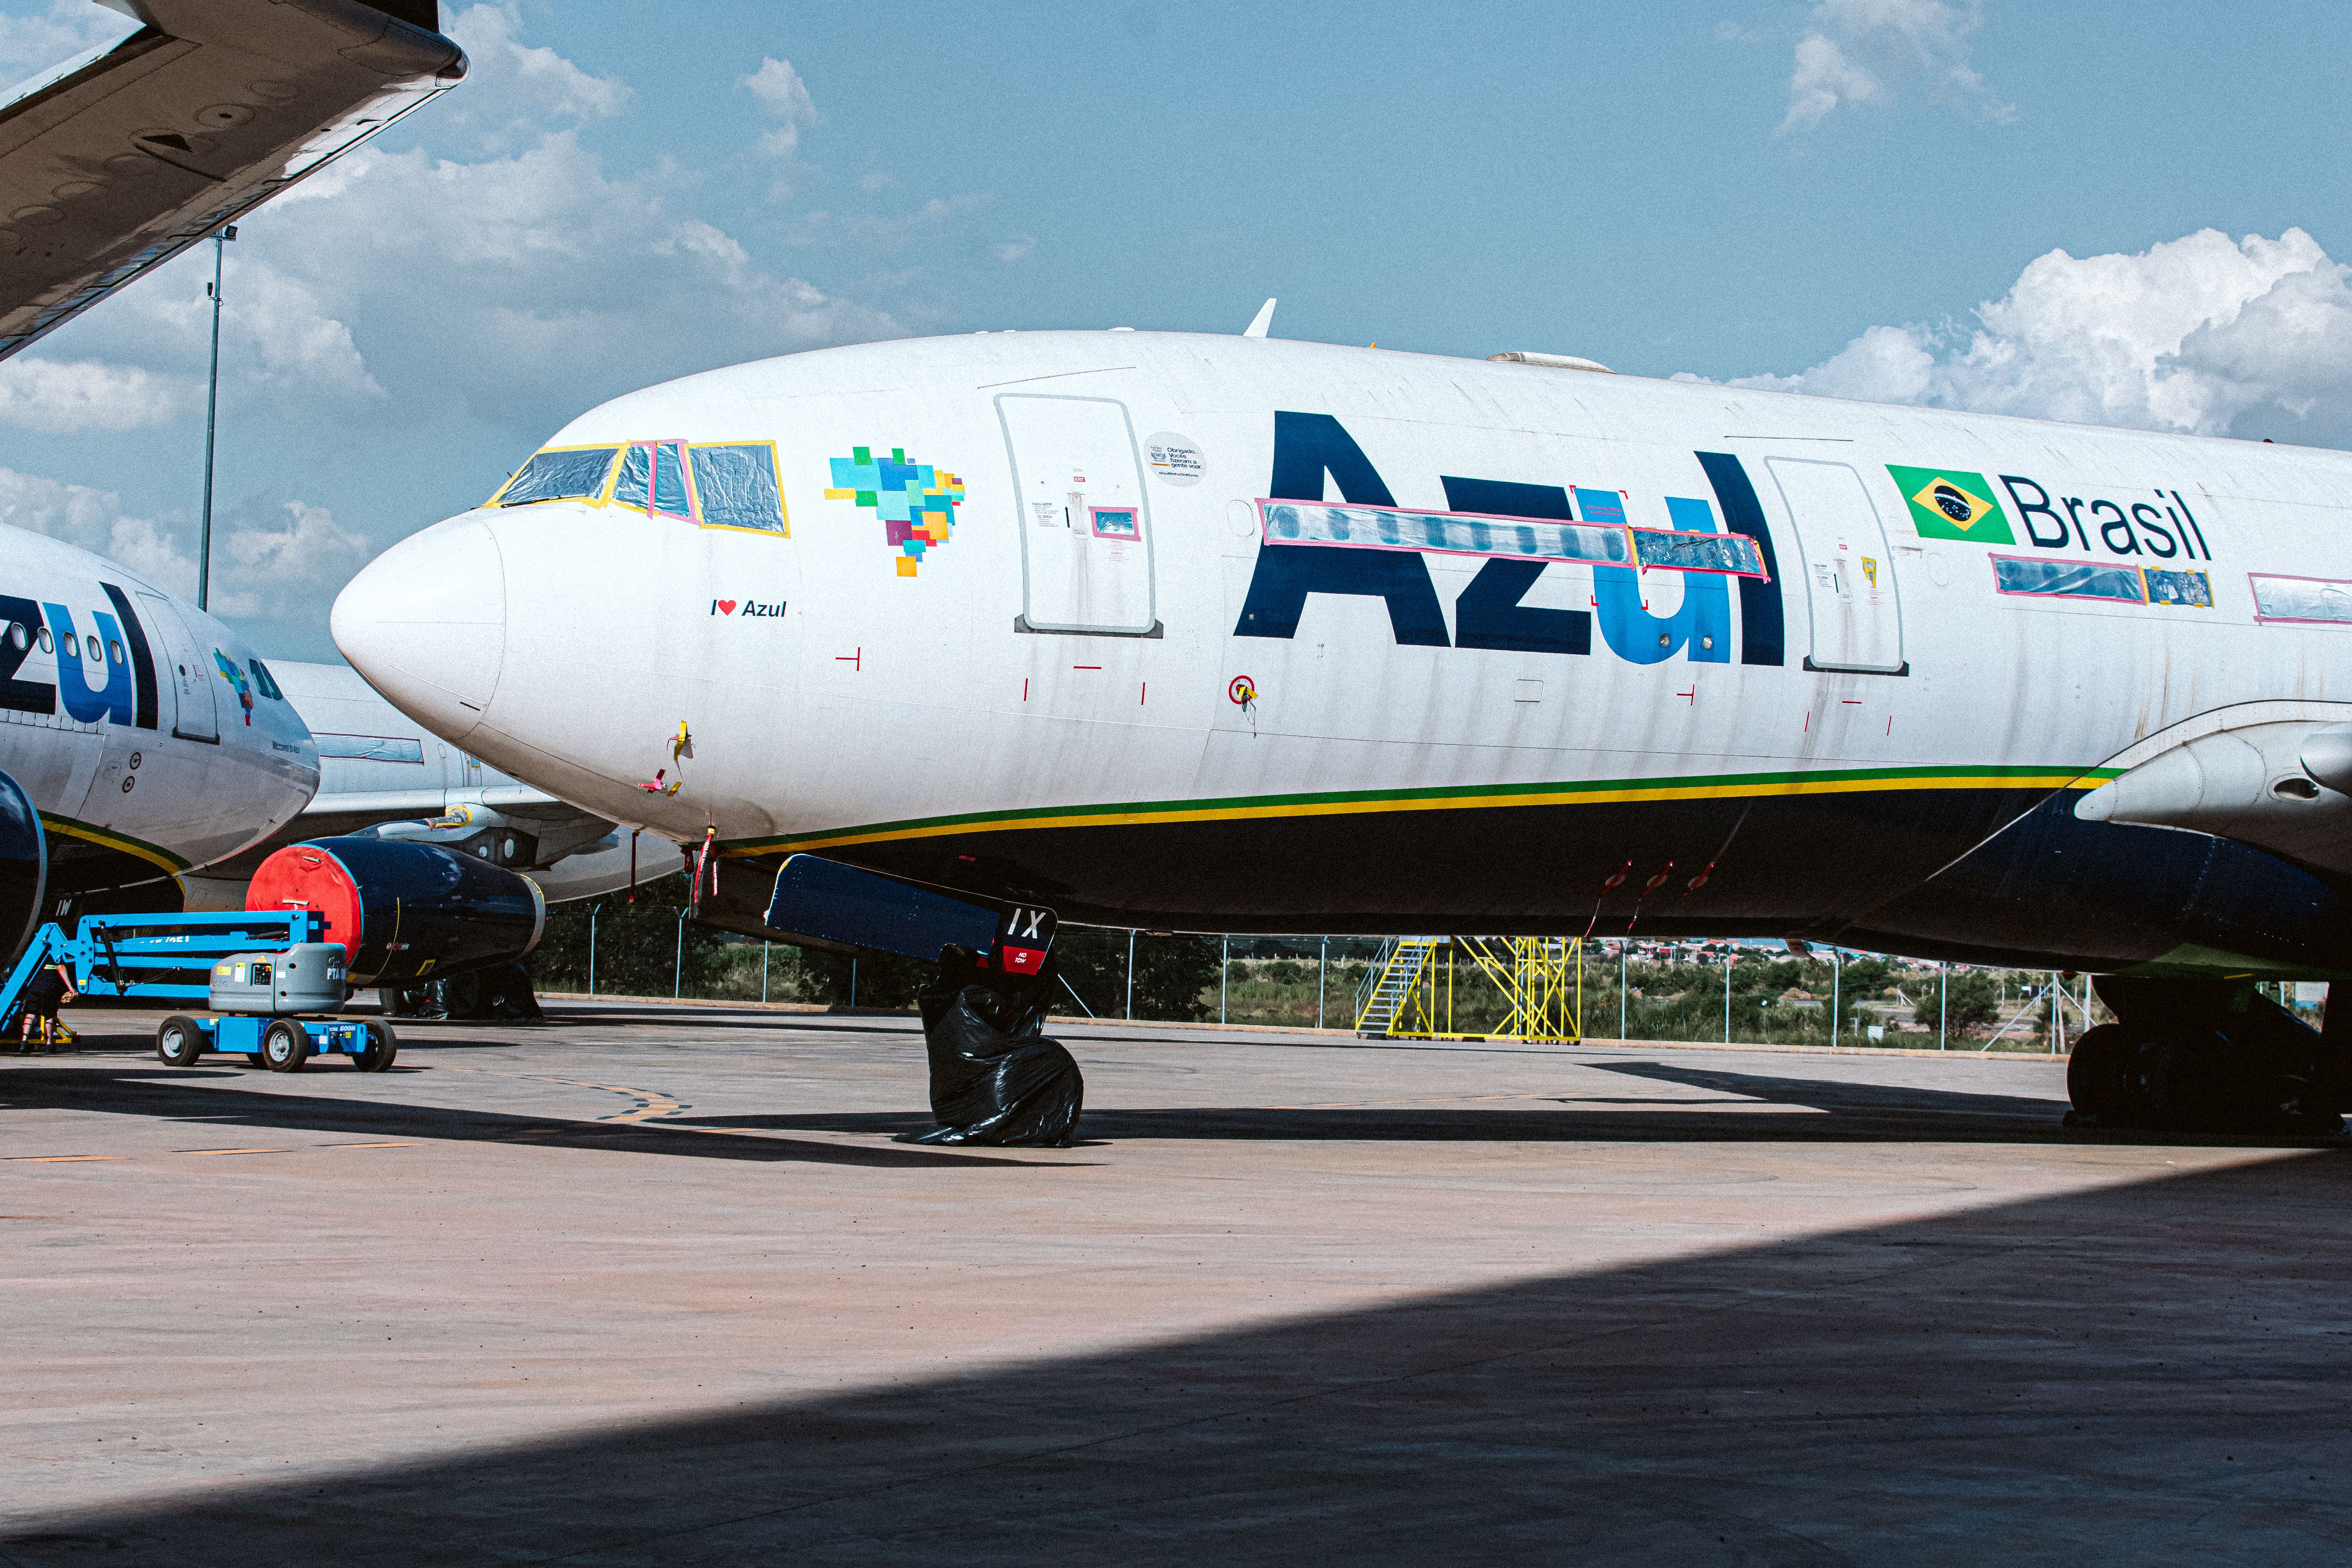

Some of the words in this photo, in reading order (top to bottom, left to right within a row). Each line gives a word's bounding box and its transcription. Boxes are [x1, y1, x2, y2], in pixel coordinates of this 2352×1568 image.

[1233, 410, 1784, 667] Azul
[1998, 475, 2212, 561] Brasil
[711, 599, 717, 615] I
[741, 600, 787, 617] Azul
[1007, 908, 1046, 939] IX
